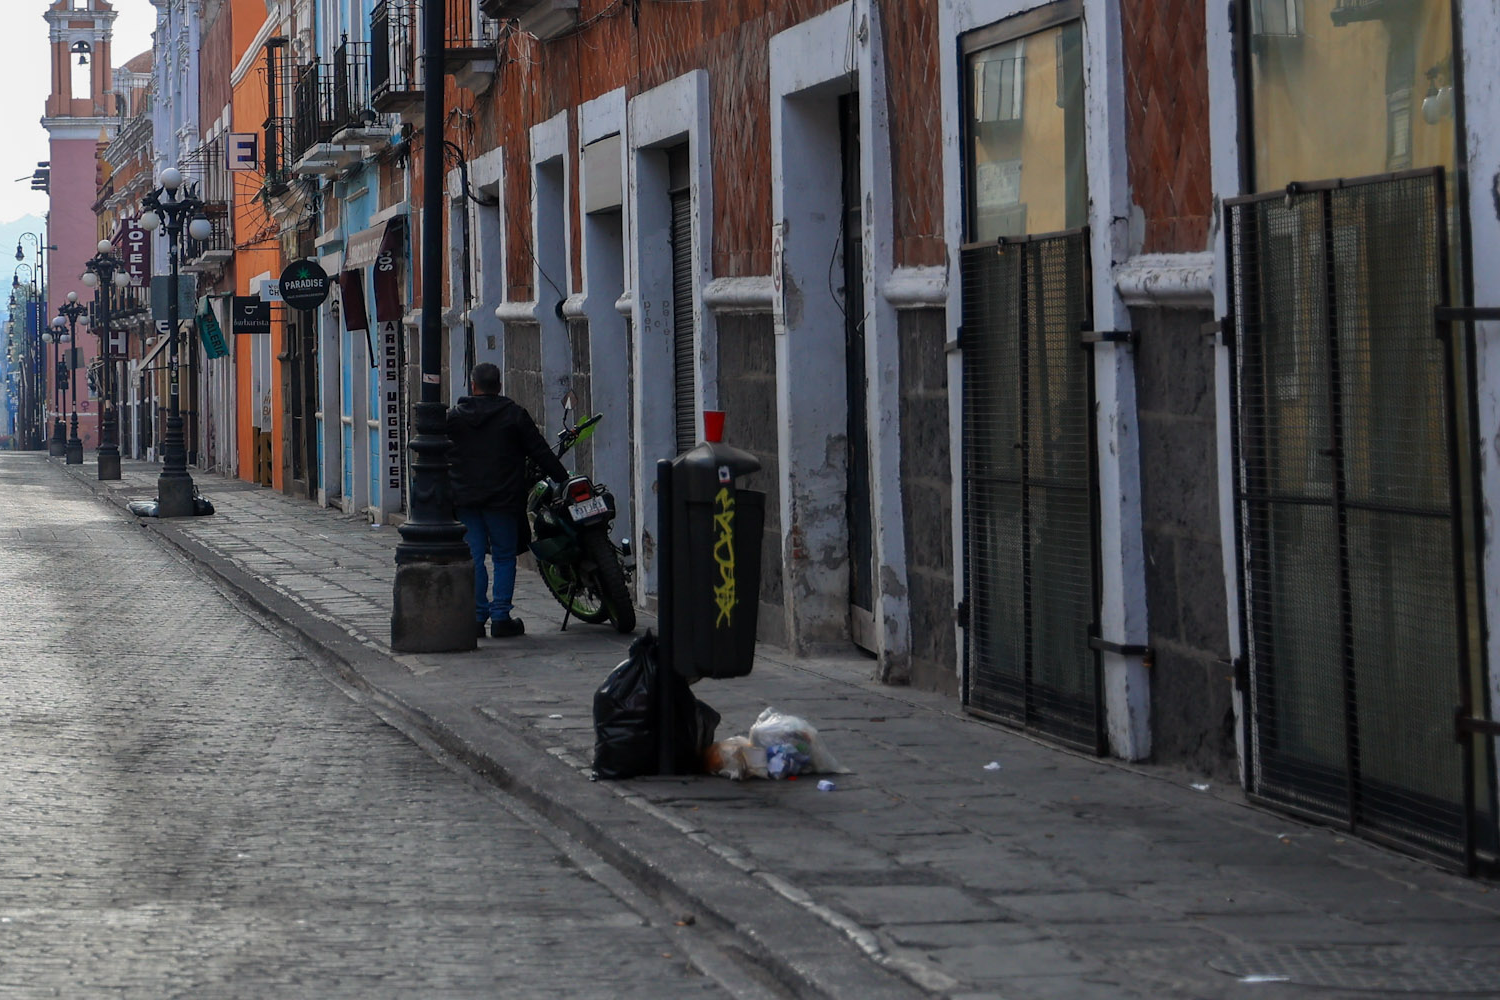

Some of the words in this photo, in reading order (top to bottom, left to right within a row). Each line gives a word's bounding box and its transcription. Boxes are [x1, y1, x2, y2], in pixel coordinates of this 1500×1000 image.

[229, 135, 254, 168] E
[128, 220, 143, 274] HOTEL
[285, 279, 323, 290] PARADISE
[385, 321, 396, 381] ARCOS
[387, 391, 399, 488] URGENTES
